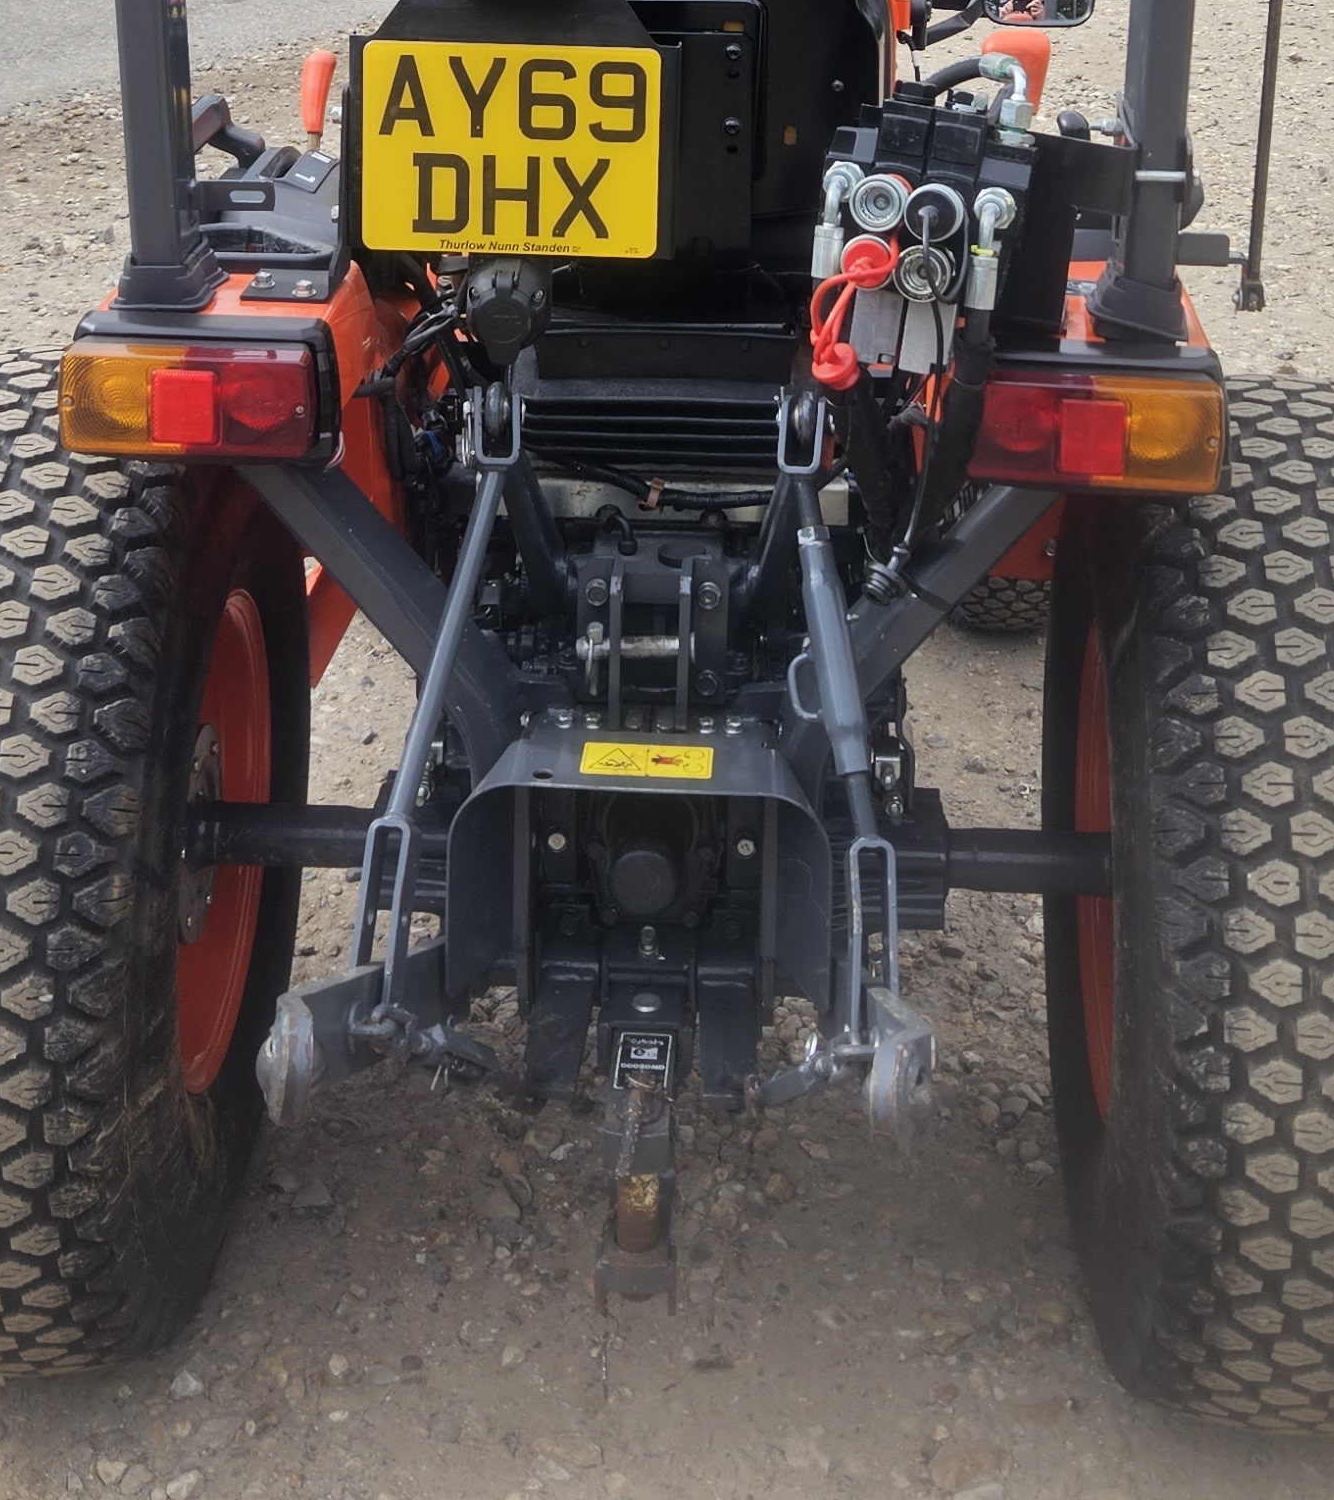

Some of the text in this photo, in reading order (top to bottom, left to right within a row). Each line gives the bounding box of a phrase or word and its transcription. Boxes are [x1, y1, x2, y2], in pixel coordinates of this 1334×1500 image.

[378, 54, 647, 143] AY69
[412, 152, 611, 239] DHX
[439, 239, 486, 250] Thurlow
[488, 241, 519, 251] Nunn
[522, 242, 570, 253] Standen
